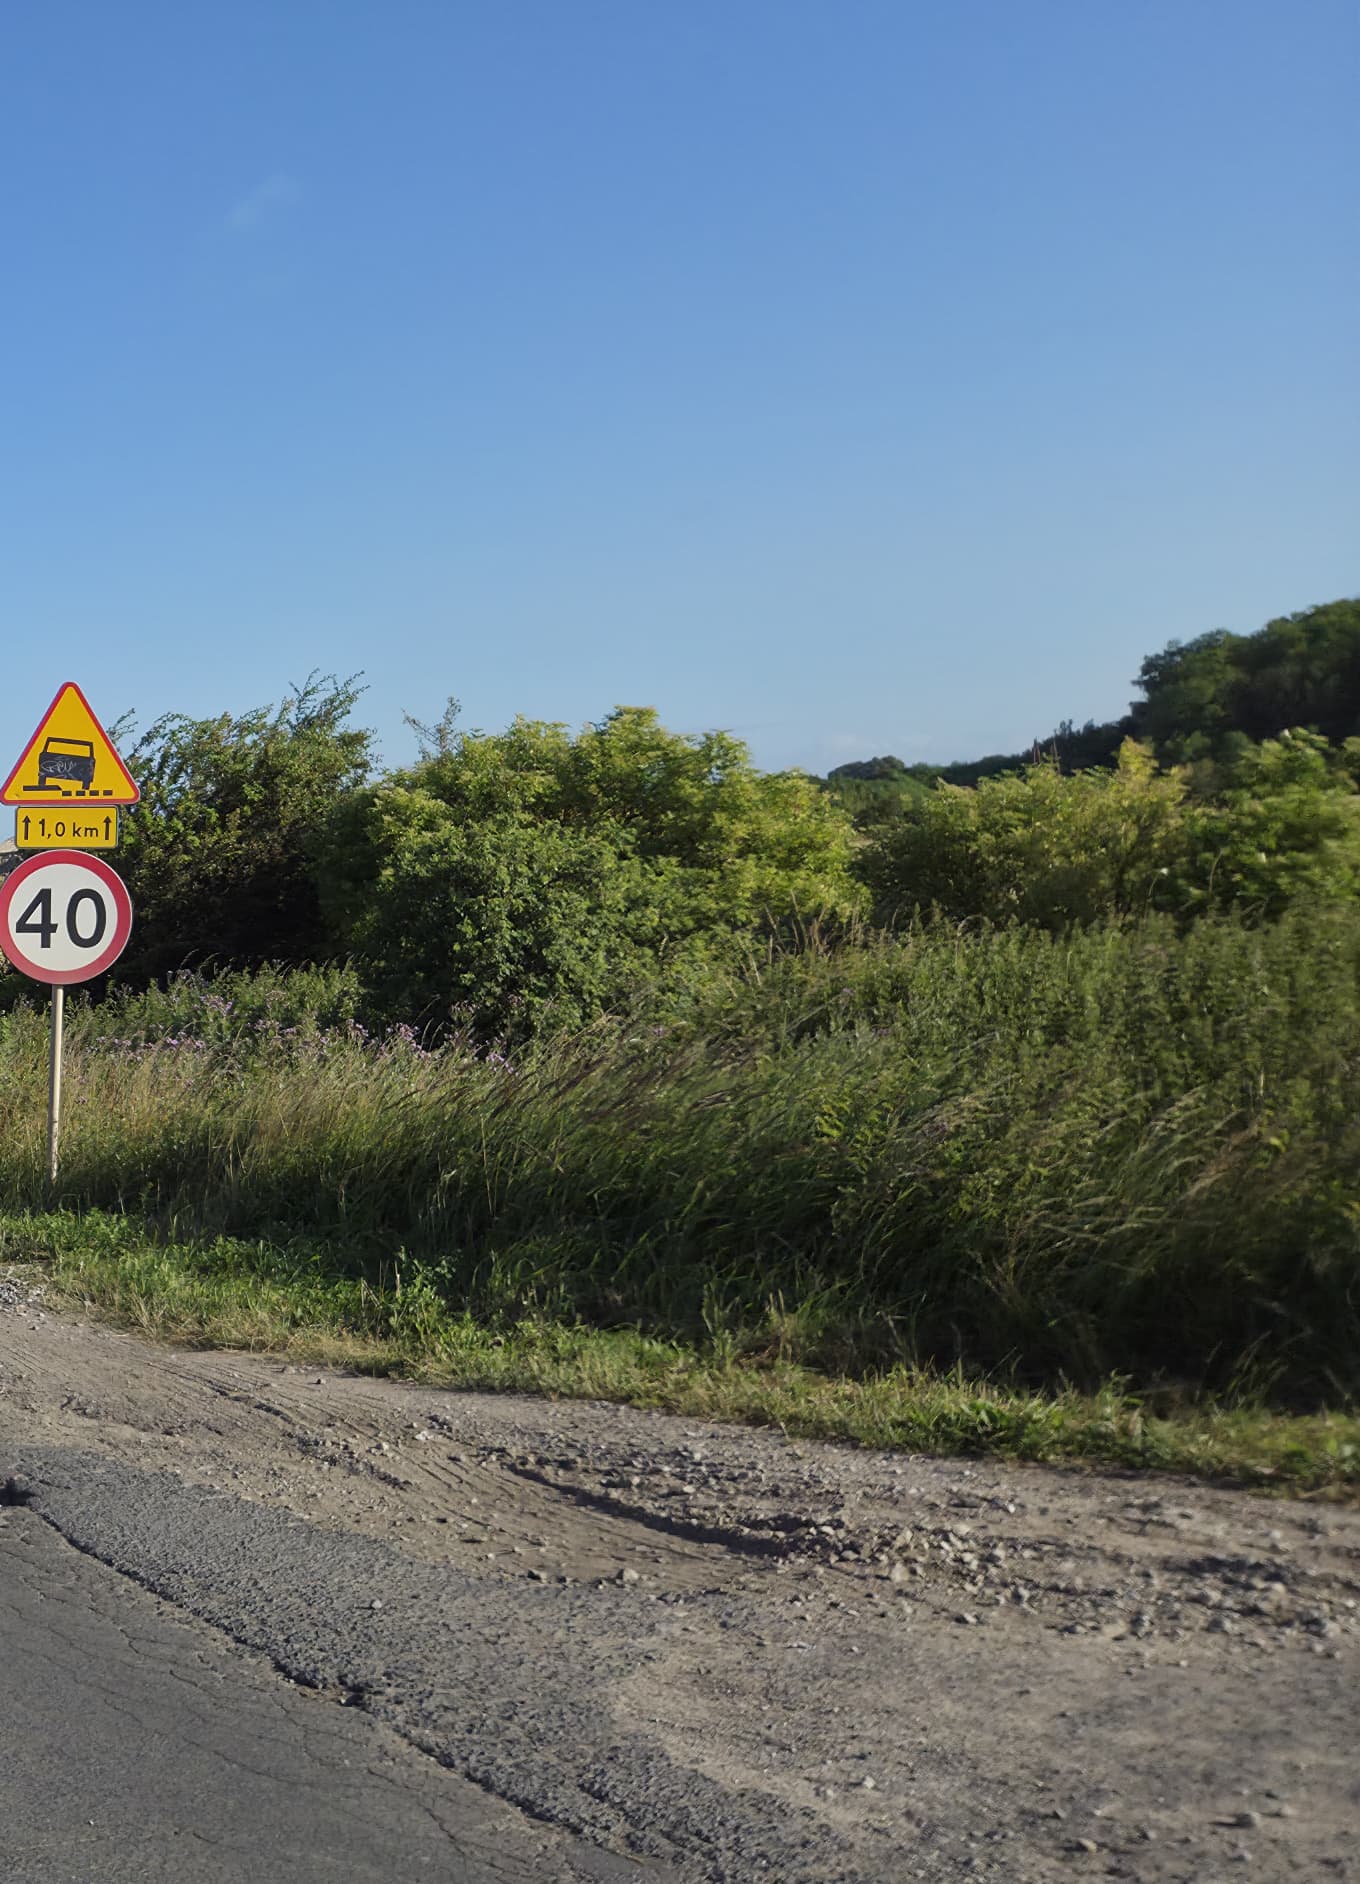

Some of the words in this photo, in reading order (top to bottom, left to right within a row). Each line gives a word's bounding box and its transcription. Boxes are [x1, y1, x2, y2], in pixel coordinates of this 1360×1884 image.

[38, 818, 65, 839] 1,0
[72, 822, 99, 838] km
[15, 888, 107, 949] 40
